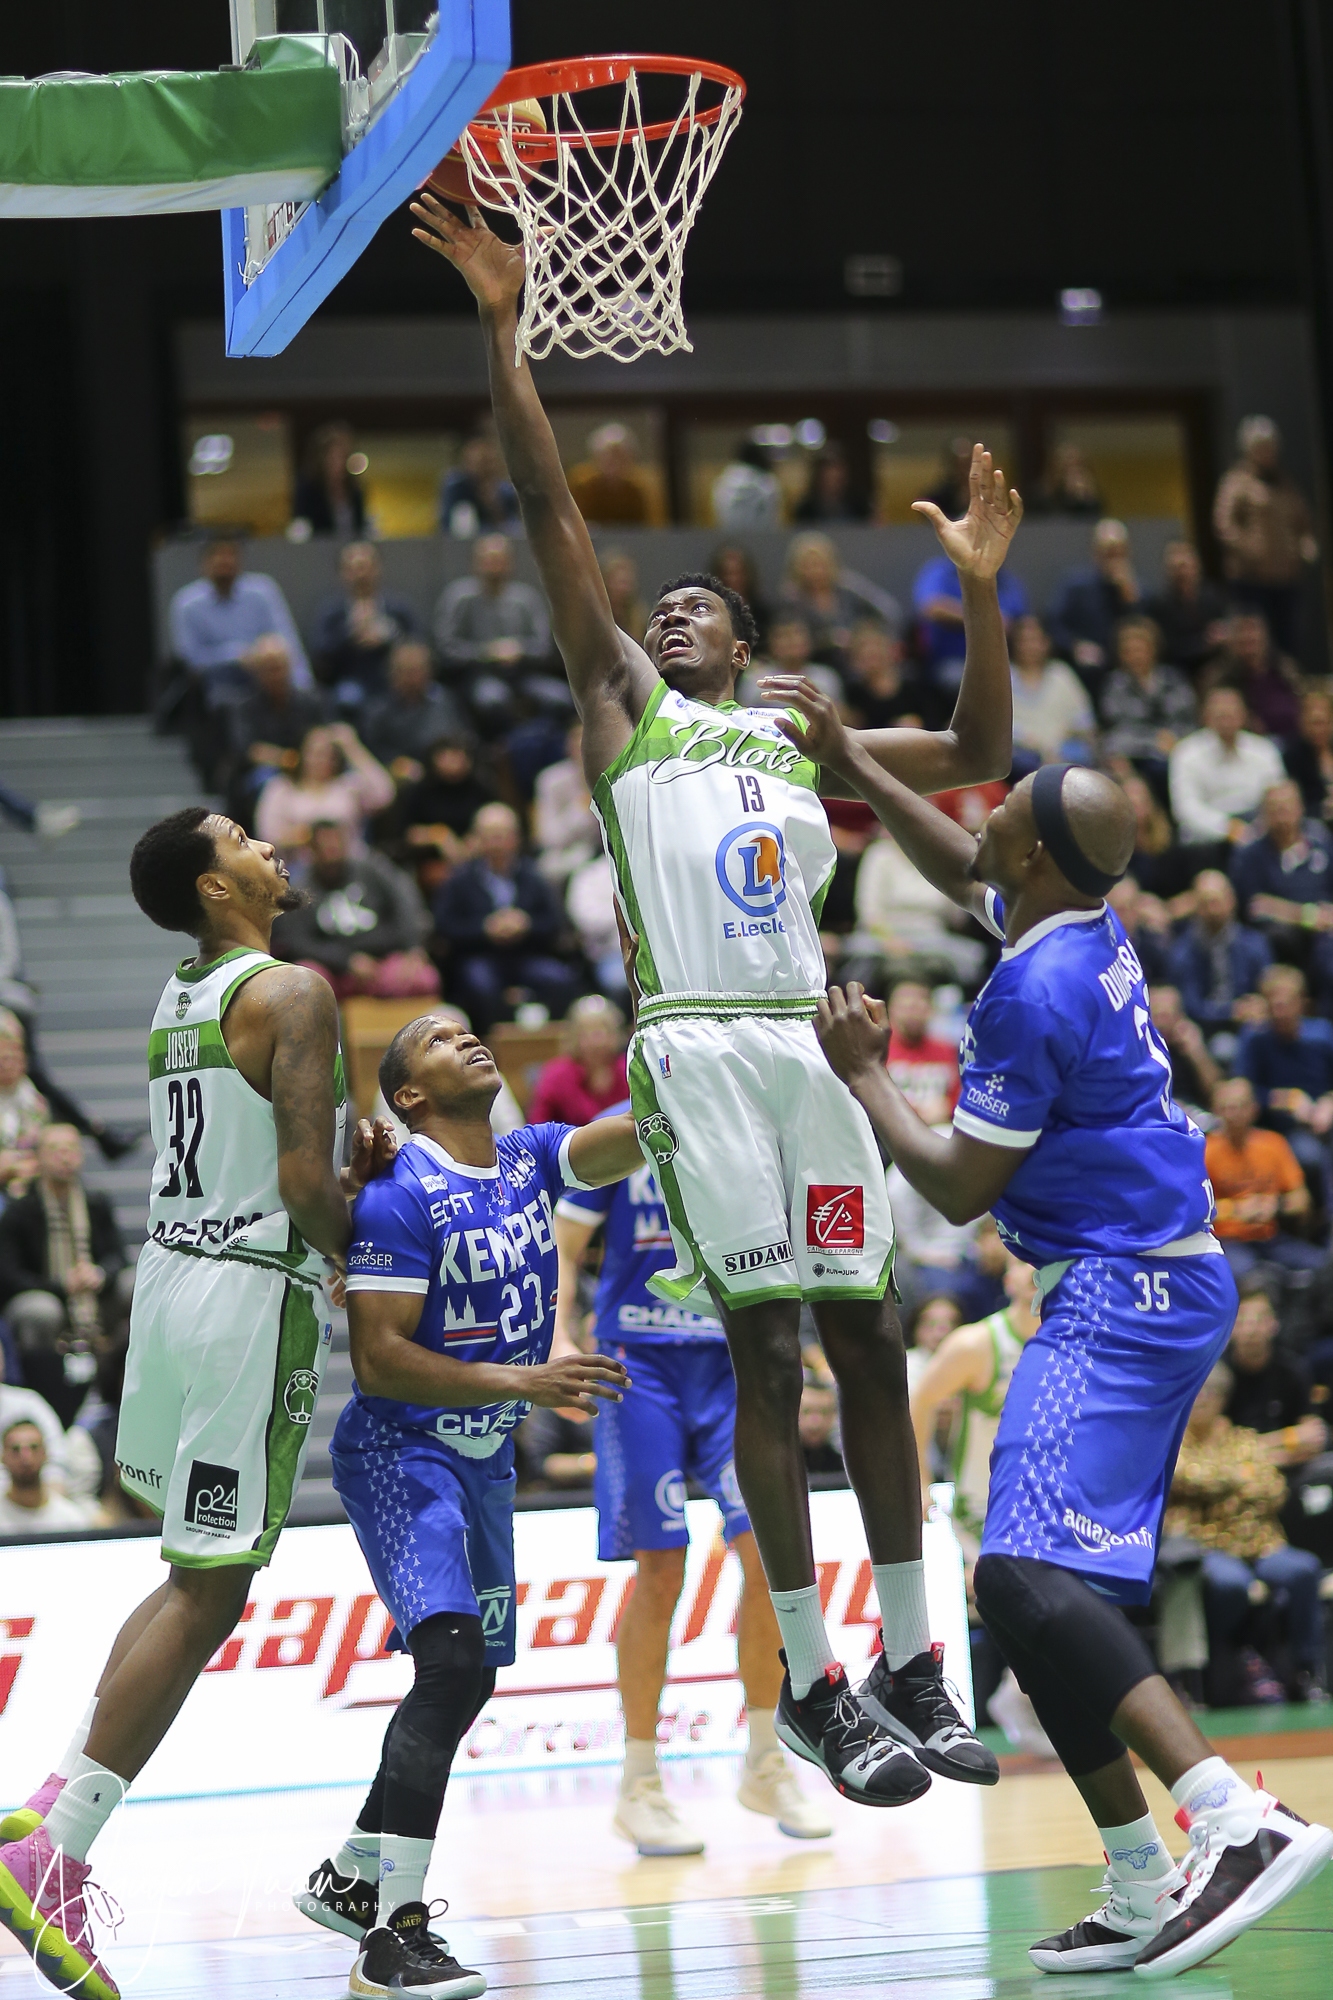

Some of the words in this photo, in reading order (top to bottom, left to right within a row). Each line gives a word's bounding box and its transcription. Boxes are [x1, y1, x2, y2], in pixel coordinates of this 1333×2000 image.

[649, 719, 806, 784] Blois
[735, 775, 766, 812] 13
[164, 1028, 200, 1071] JOSEPH
[966, 1087, 1010, 1117] CORSER
[158, 1077, 205, 1198] 32
[499, 1271, 544, 1344] 23
[1133, 1271, 1171, 1312] 35
[1062, 1507, 1154, 1550] amazon.fr
